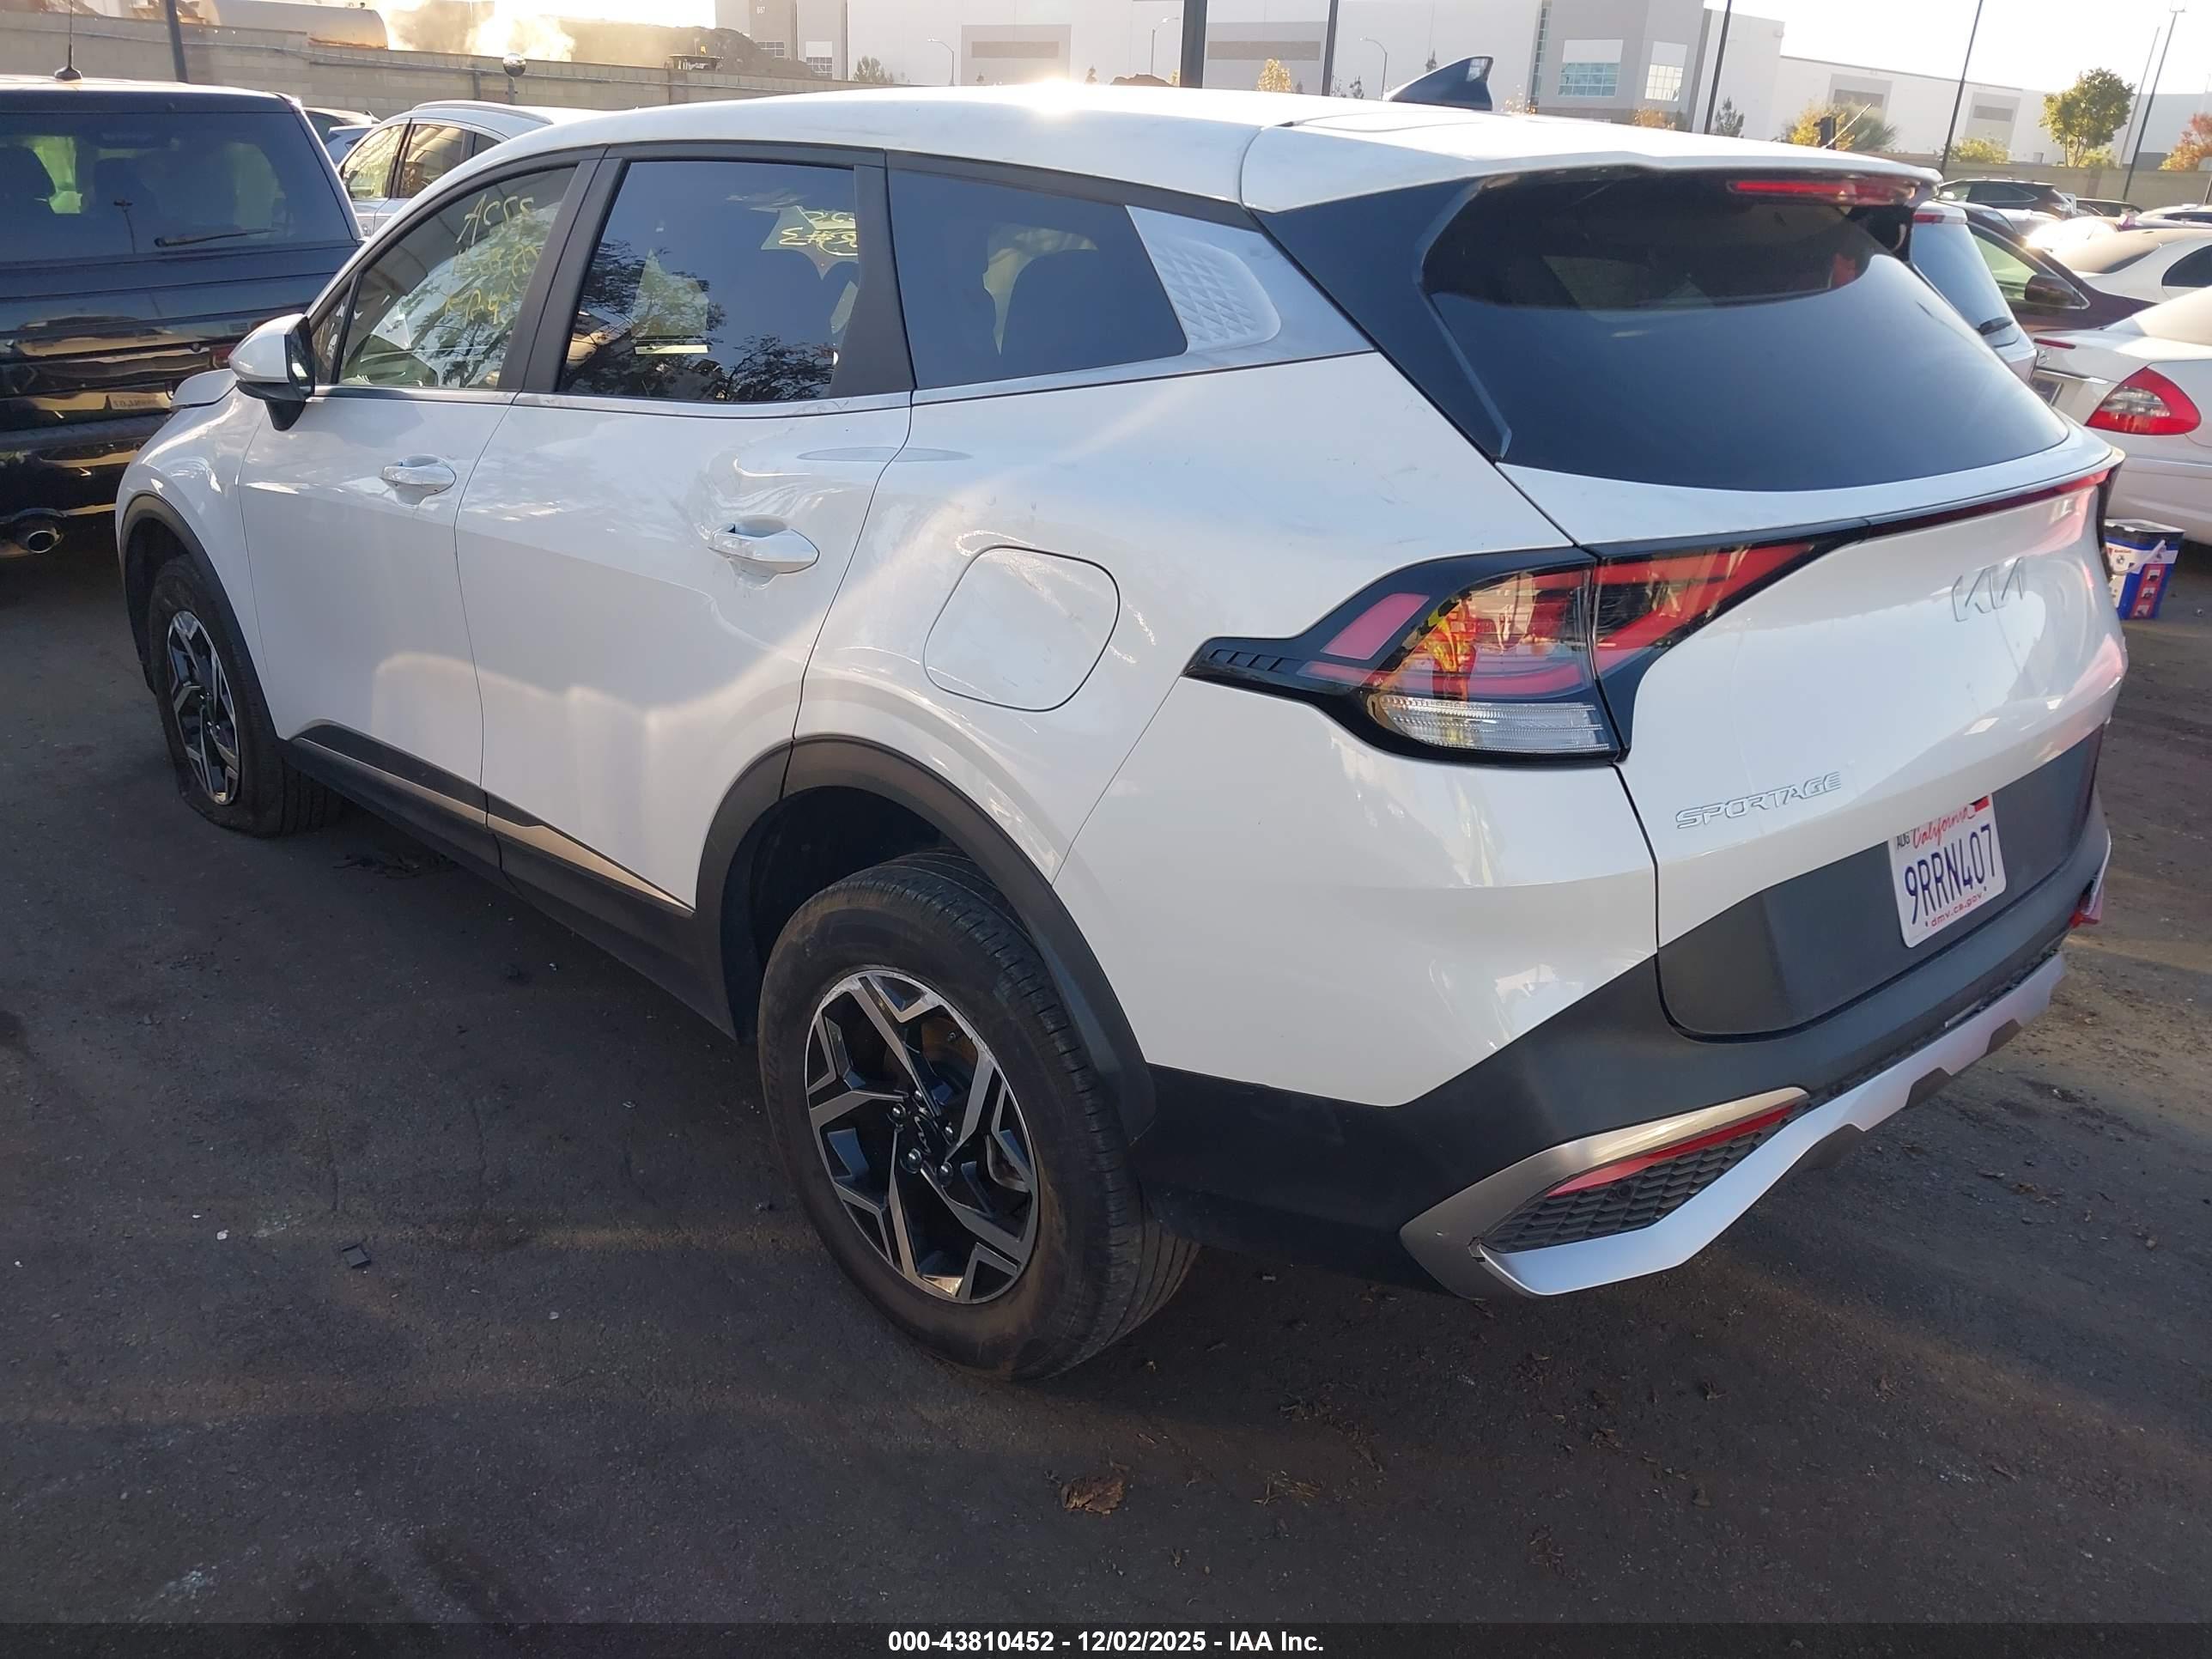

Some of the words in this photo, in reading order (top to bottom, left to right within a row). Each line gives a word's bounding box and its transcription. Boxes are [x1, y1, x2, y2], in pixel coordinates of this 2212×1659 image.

[1951, 556, 2025, 623] KIA
[1675, 771, 1842, 830] SPORTAGE
[1911, 805, 1977, 849] California
[1904, 823, 1996, 925] 9RRN407
[1931, 891, 1984, 927] dmv.ca.gov
